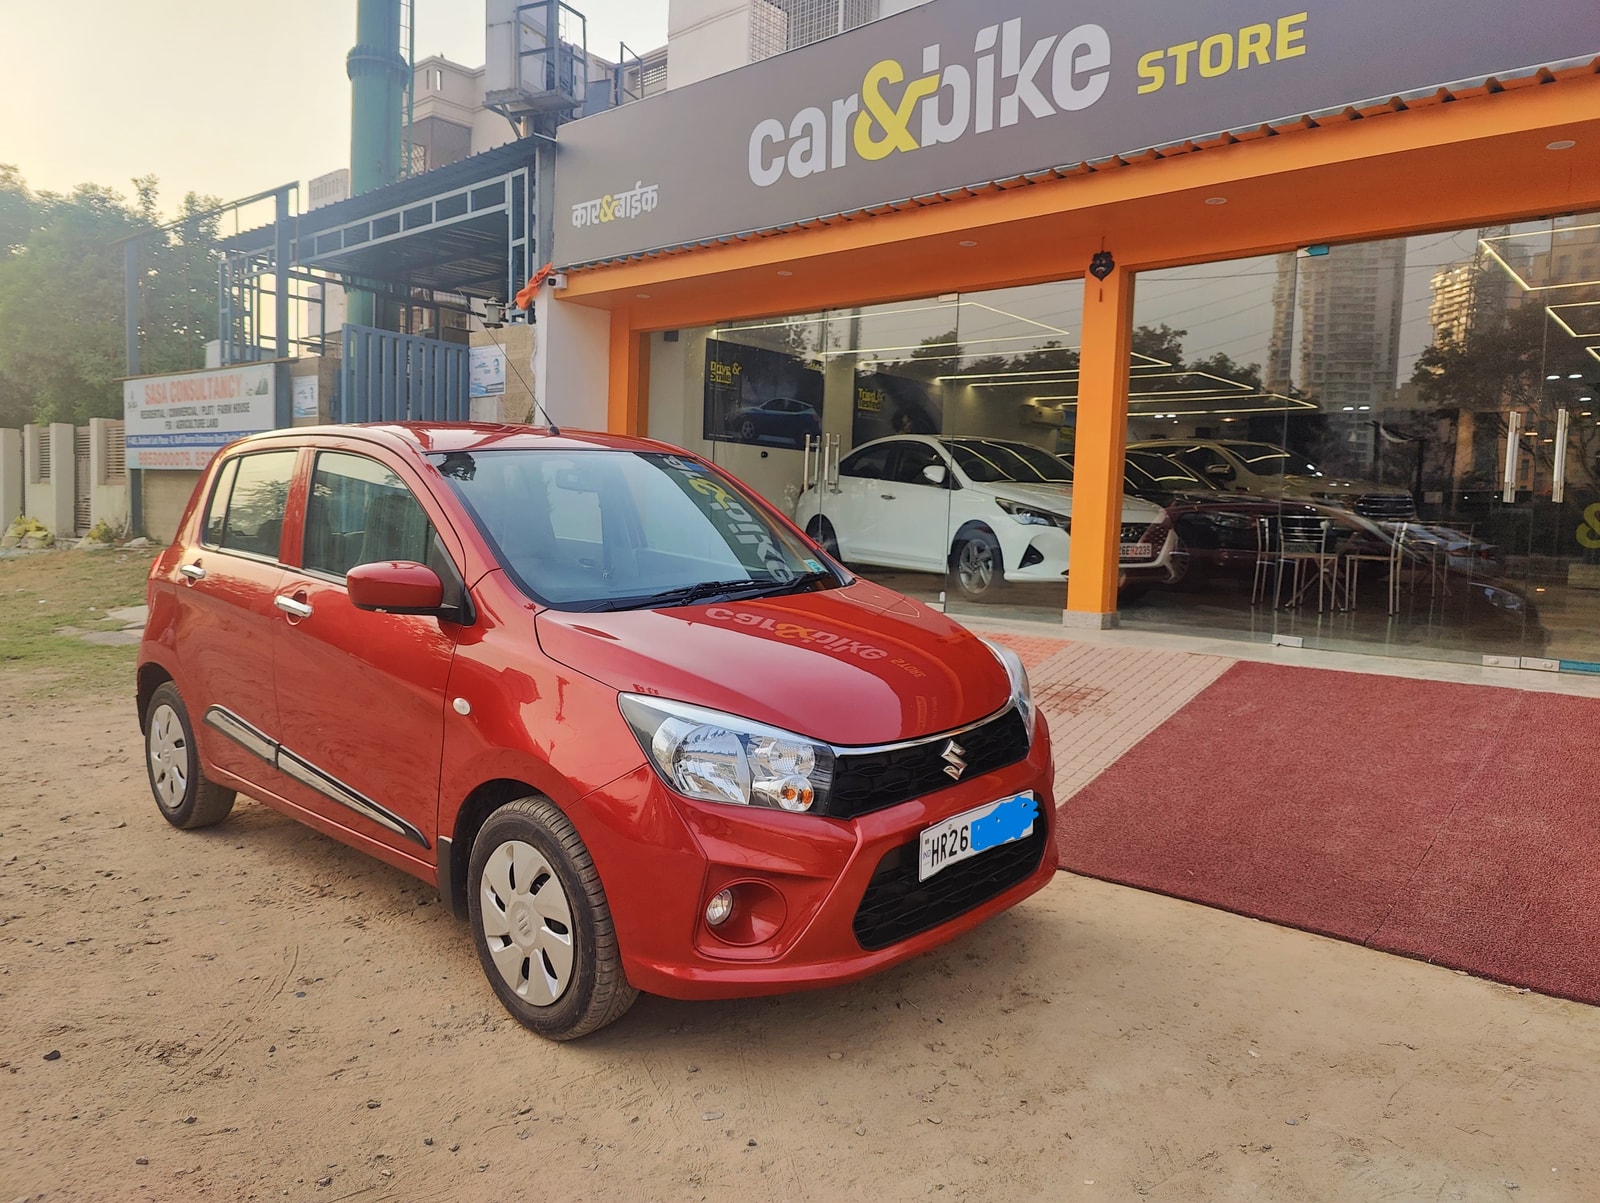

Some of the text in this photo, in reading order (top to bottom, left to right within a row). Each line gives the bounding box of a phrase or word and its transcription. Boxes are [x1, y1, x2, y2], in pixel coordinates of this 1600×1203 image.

[748, 12, 1308, 187] car&bike STORE
[145, 374, 242, 405] SASA CONSULTANCY
